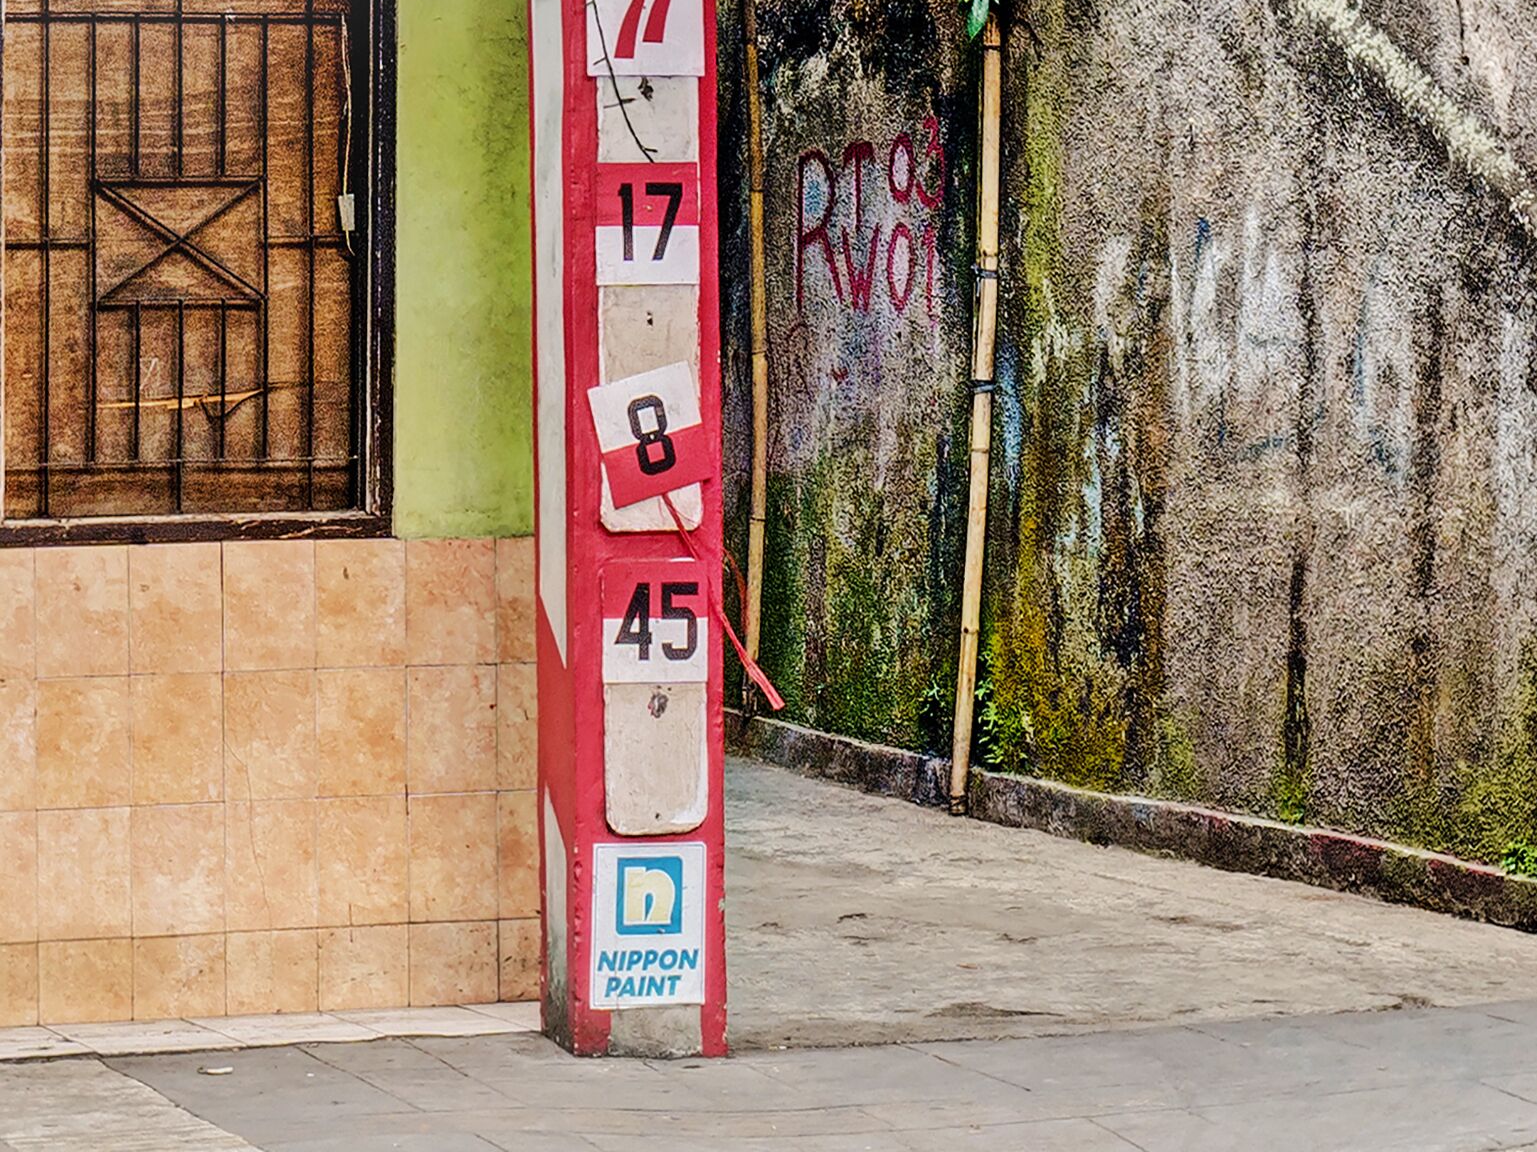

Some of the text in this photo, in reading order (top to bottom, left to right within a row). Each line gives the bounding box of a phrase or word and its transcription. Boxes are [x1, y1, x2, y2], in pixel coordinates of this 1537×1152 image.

[888, 115, 945, 209] 03
[618, 182, 683, 261] 17
[887, 223, 936, 318] 01
[627, 395, 676, 476] 8
[614, 582, 699, 661] 45
[598, 949, 699, 972] NIPPON
[604, 975, 681, 998] PAINT
